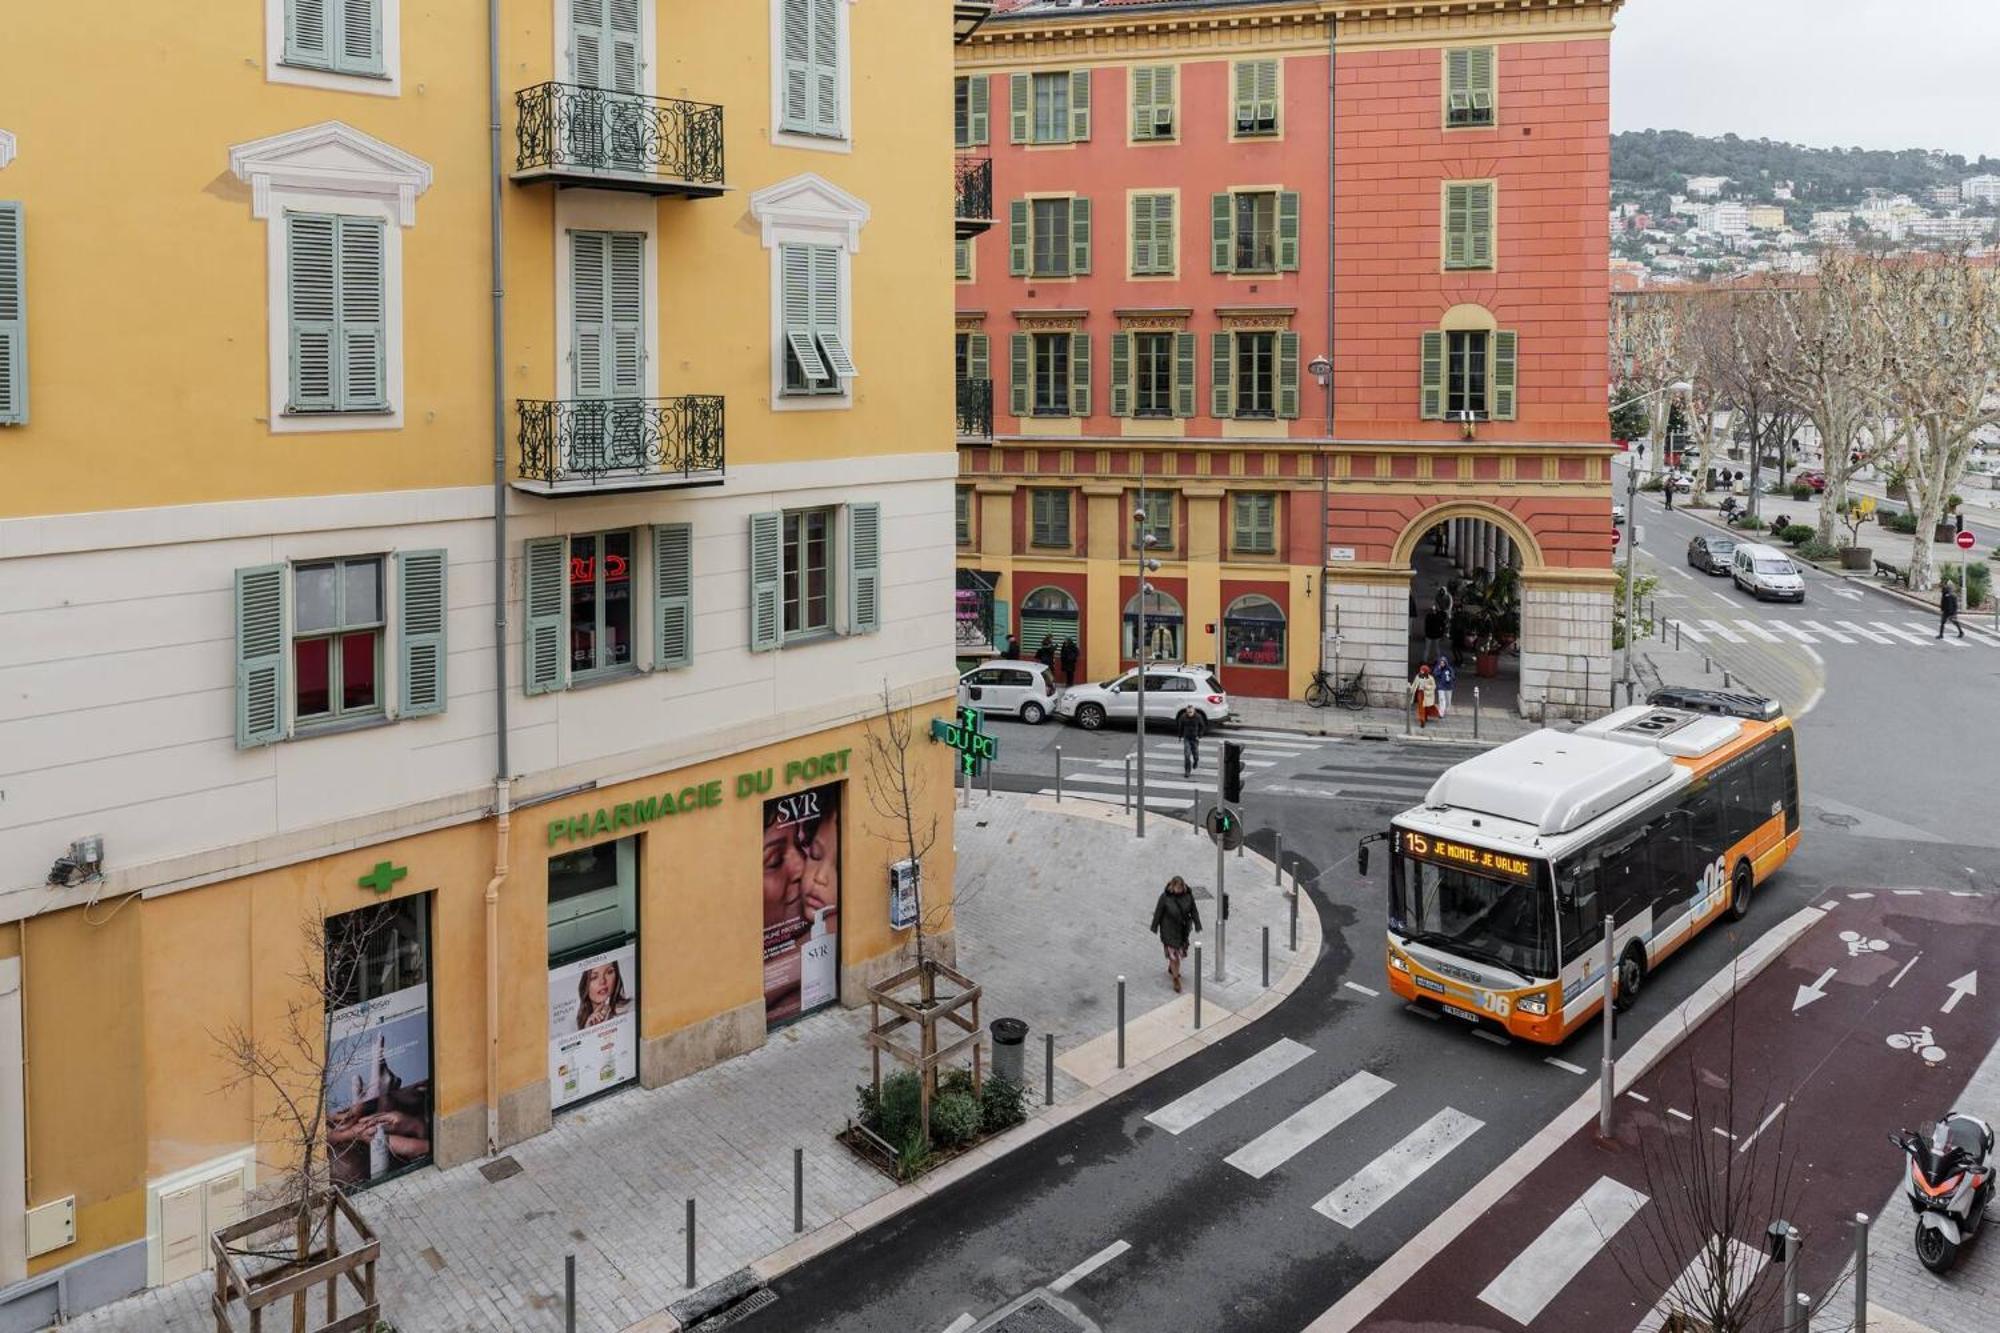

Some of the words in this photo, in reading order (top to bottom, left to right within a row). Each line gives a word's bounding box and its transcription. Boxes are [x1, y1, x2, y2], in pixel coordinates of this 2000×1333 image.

[946, 725, 969, 749] DU
[547, 780, 723, 846] PHARMACIE
[736, 767, 773, 799] DU
[785, 748, 852, 785] PORT
[776, 792, 821, 823] SVR
[1406, 833, 1428, 854] 15
[1434, 841, 1446, 856] JE
[1481, 853, 1495, 867] JE
[1495, 856, 1528, 876] VALIDE
[1704, 855, 1725, 905] 06
[808, 944, 829, 958] SVR
[1483, 991, 1511, 1017] 06
